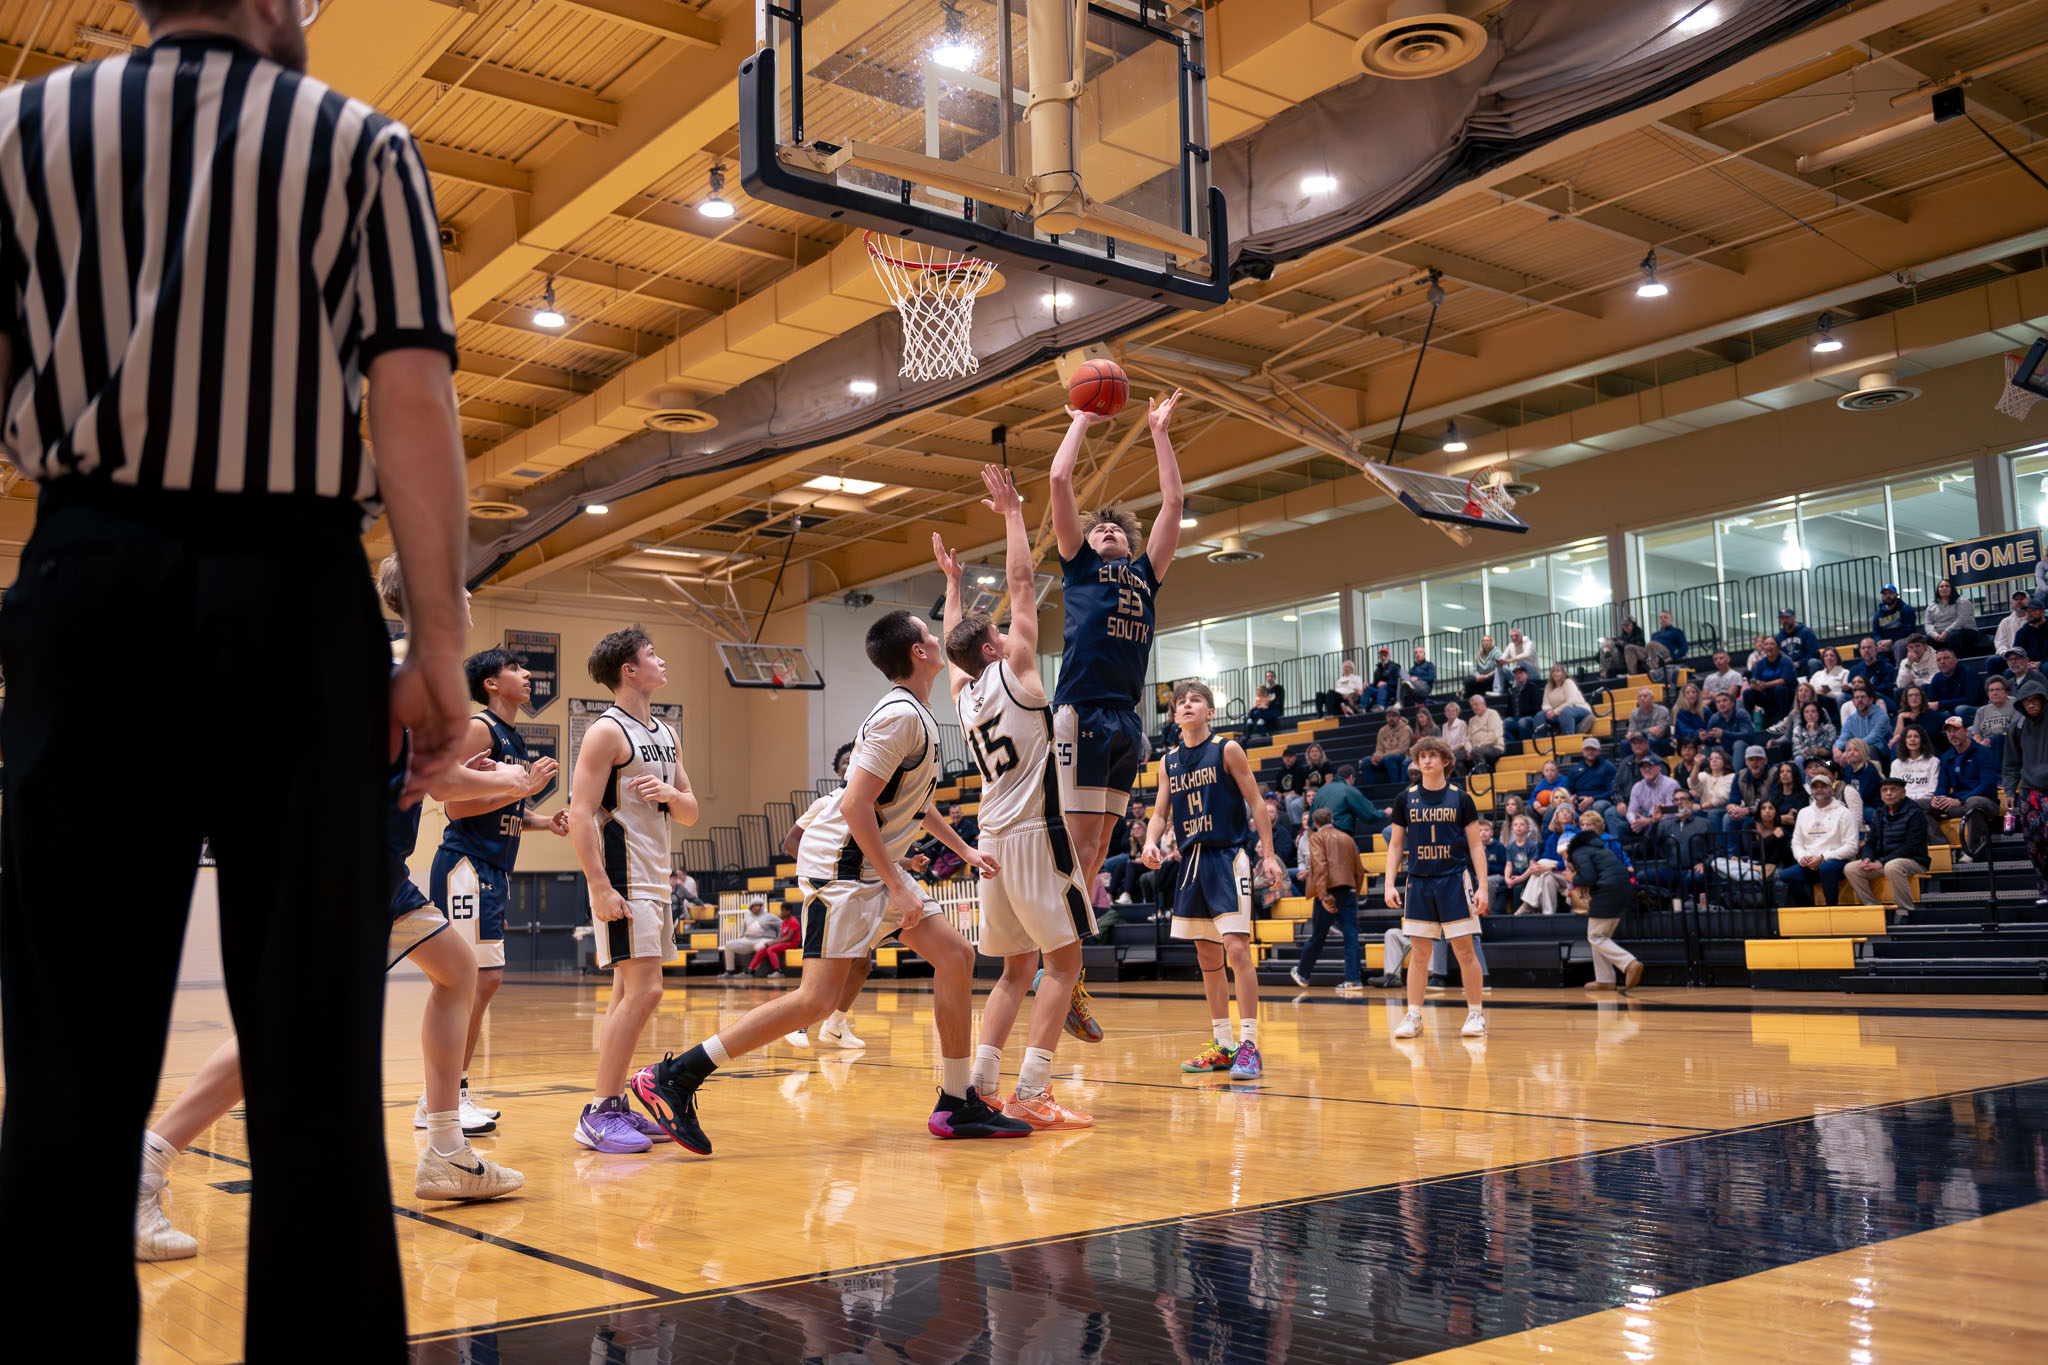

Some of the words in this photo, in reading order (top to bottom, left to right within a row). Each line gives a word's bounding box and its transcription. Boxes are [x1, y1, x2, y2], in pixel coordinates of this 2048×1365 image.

[1949, 539, 2036, 576] HOME
[1117, 588, 1144, 617] 23
[1106, 616, 1150, 644] SOUTH
[969, 709, 1019, 784] 15
[1169, 766, 1218, 794] ELKHORN
[1901, 773, 1929, 785] Storm
[1186, 790, 1203, 816] 14
[1409, 807, 1457, 823] ELKHORN
[1430, 824, 1436, 843] 1
[1417, 845, 1451, 860] SOUTH
[452, 895, 473, 920] ES
